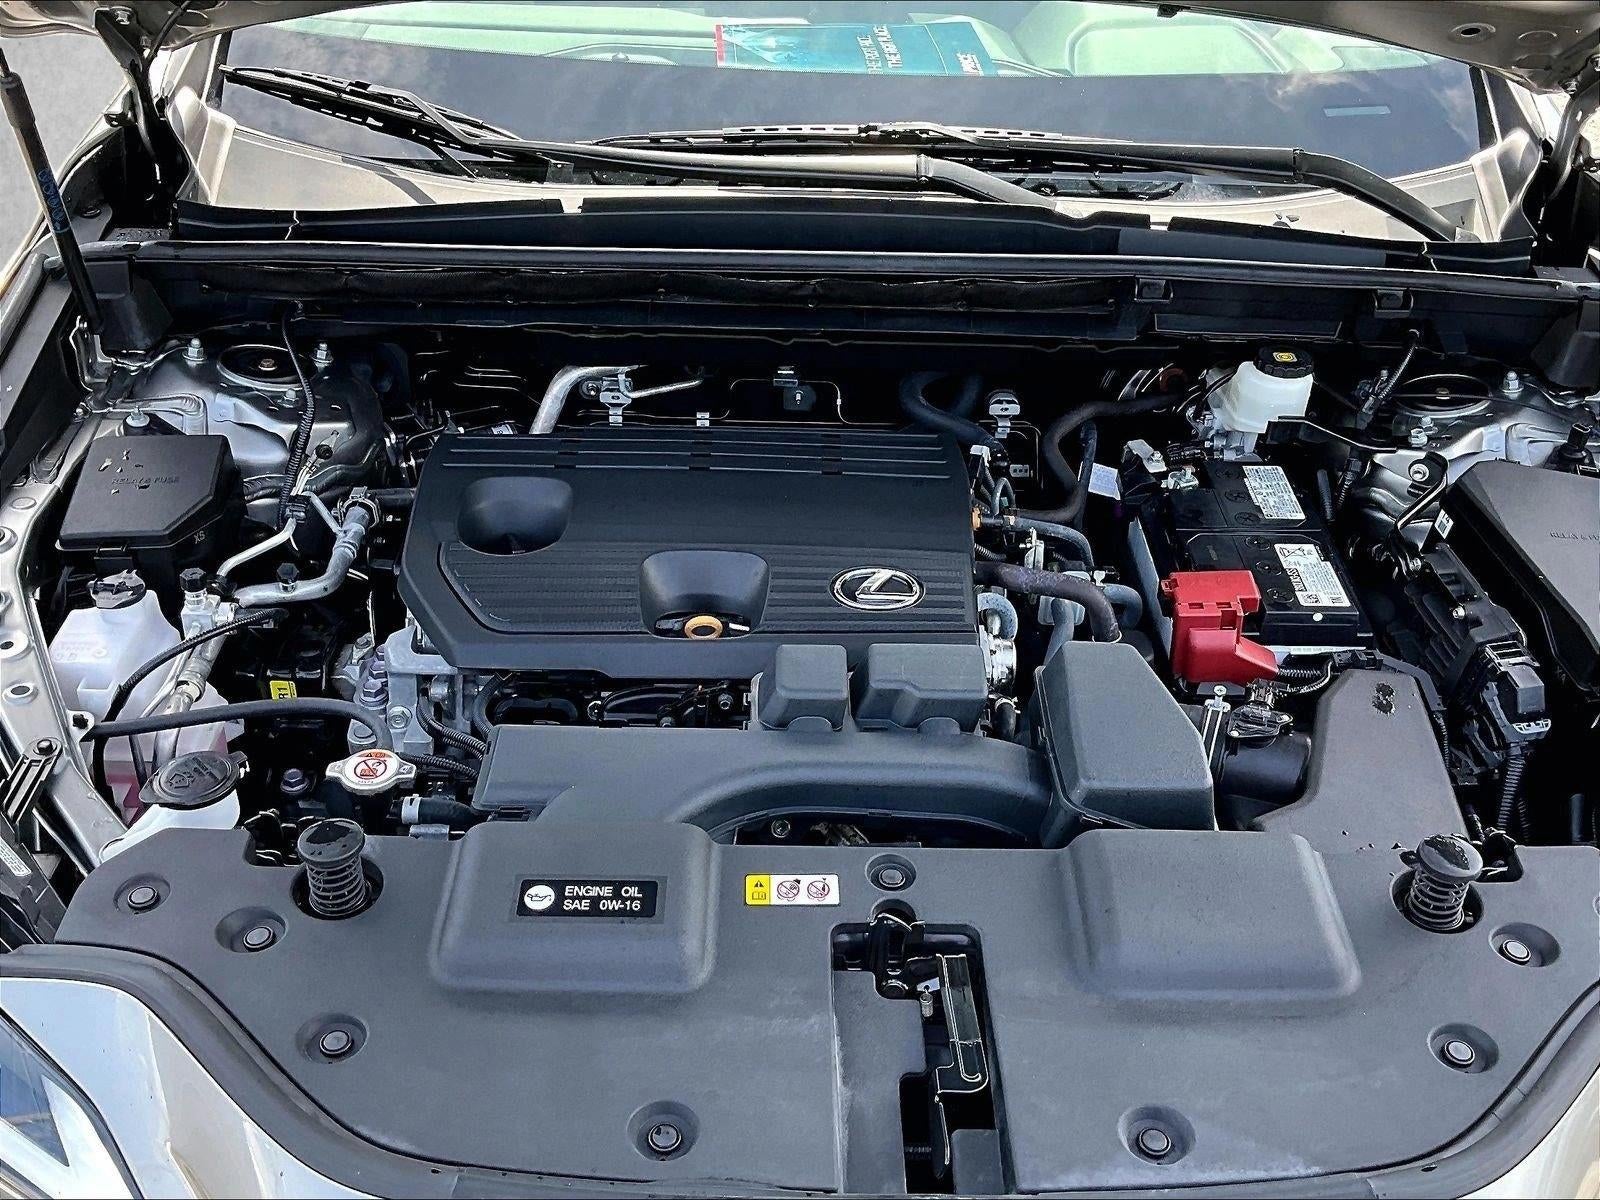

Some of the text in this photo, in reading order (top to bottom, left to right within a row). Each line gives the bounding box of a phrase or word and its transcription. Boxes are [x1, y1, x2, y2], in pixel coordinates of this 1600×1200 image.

[564, 885, 643, 897] ENGINE OIL
[562, 899, 641, 911] SAE 0W-16
